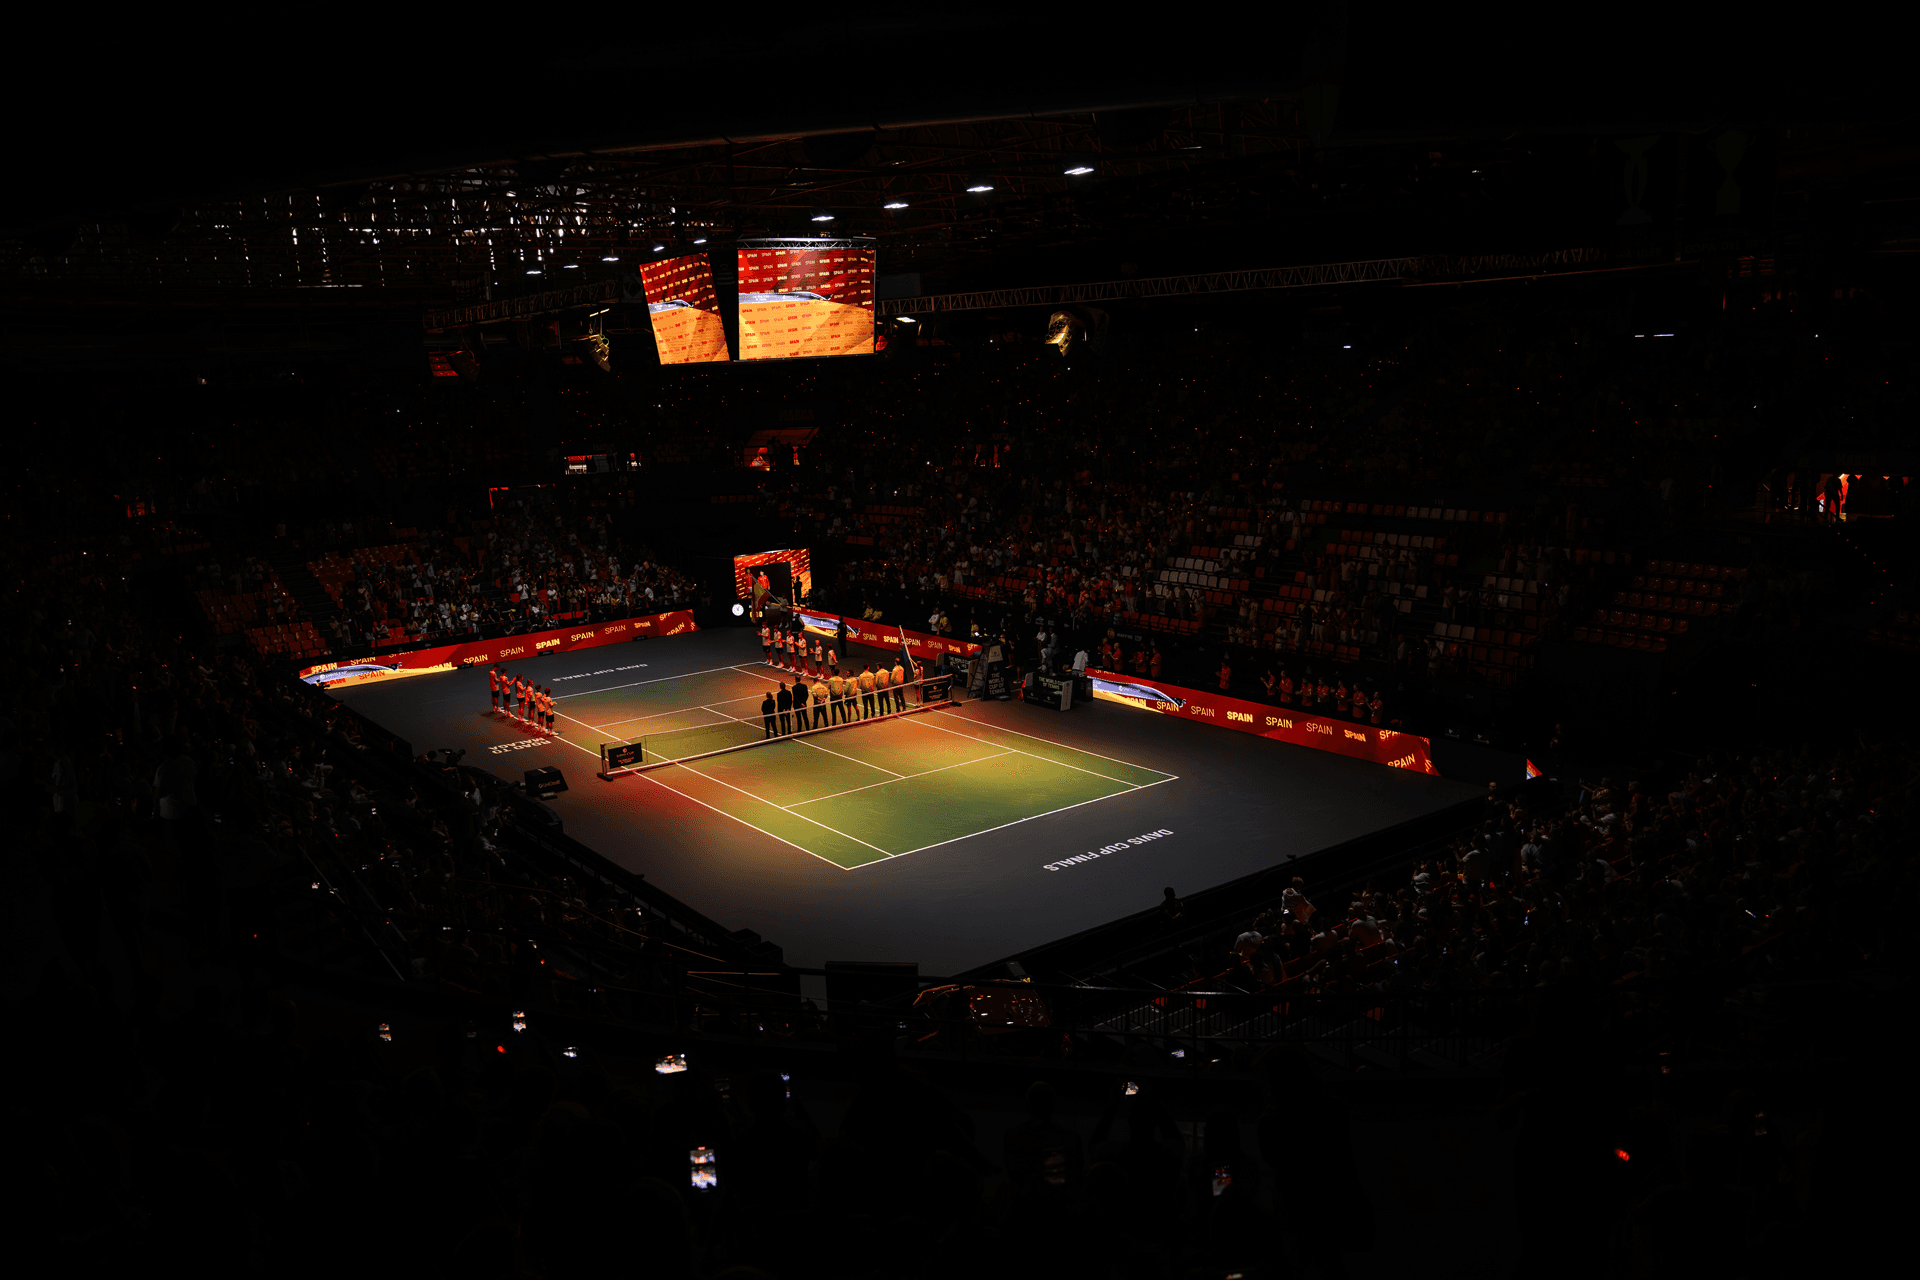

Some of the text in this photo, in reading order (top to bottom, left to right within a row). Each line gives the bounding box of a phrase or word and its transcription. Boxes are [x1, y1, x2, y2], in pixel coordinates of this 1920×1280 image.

[463, 654, 488, 664] SPAIN
[500, 646, 524, 658] SPAIN
[536, 638, 560, 650] SPAIN
[571, 631, 594, 642] SPAIN
[605, 624, 626, 635] SPAIN
[862, 633, 877, 641] SPAIN
[883, 635, 899, 644] SPAIN
[905, 637, 921, 647] SPAIN
[927, 640, 943, 650] SPAIN
[311, 662, 338, 674] SPAIN
[1156, 700, 1179, 712] SPAIN
[1190, 705, 1215, 717] SPAIN
[1226, 710, 1254, 723] SPAIN
[1265, 716, 1293, 729] SPAIN
[1306, 722, 1333, 736] SPAIN
[1387, 753, 1416, 768] SPAIN
[1043, 828, 1175, 872] DAVIS CUP FINALS
